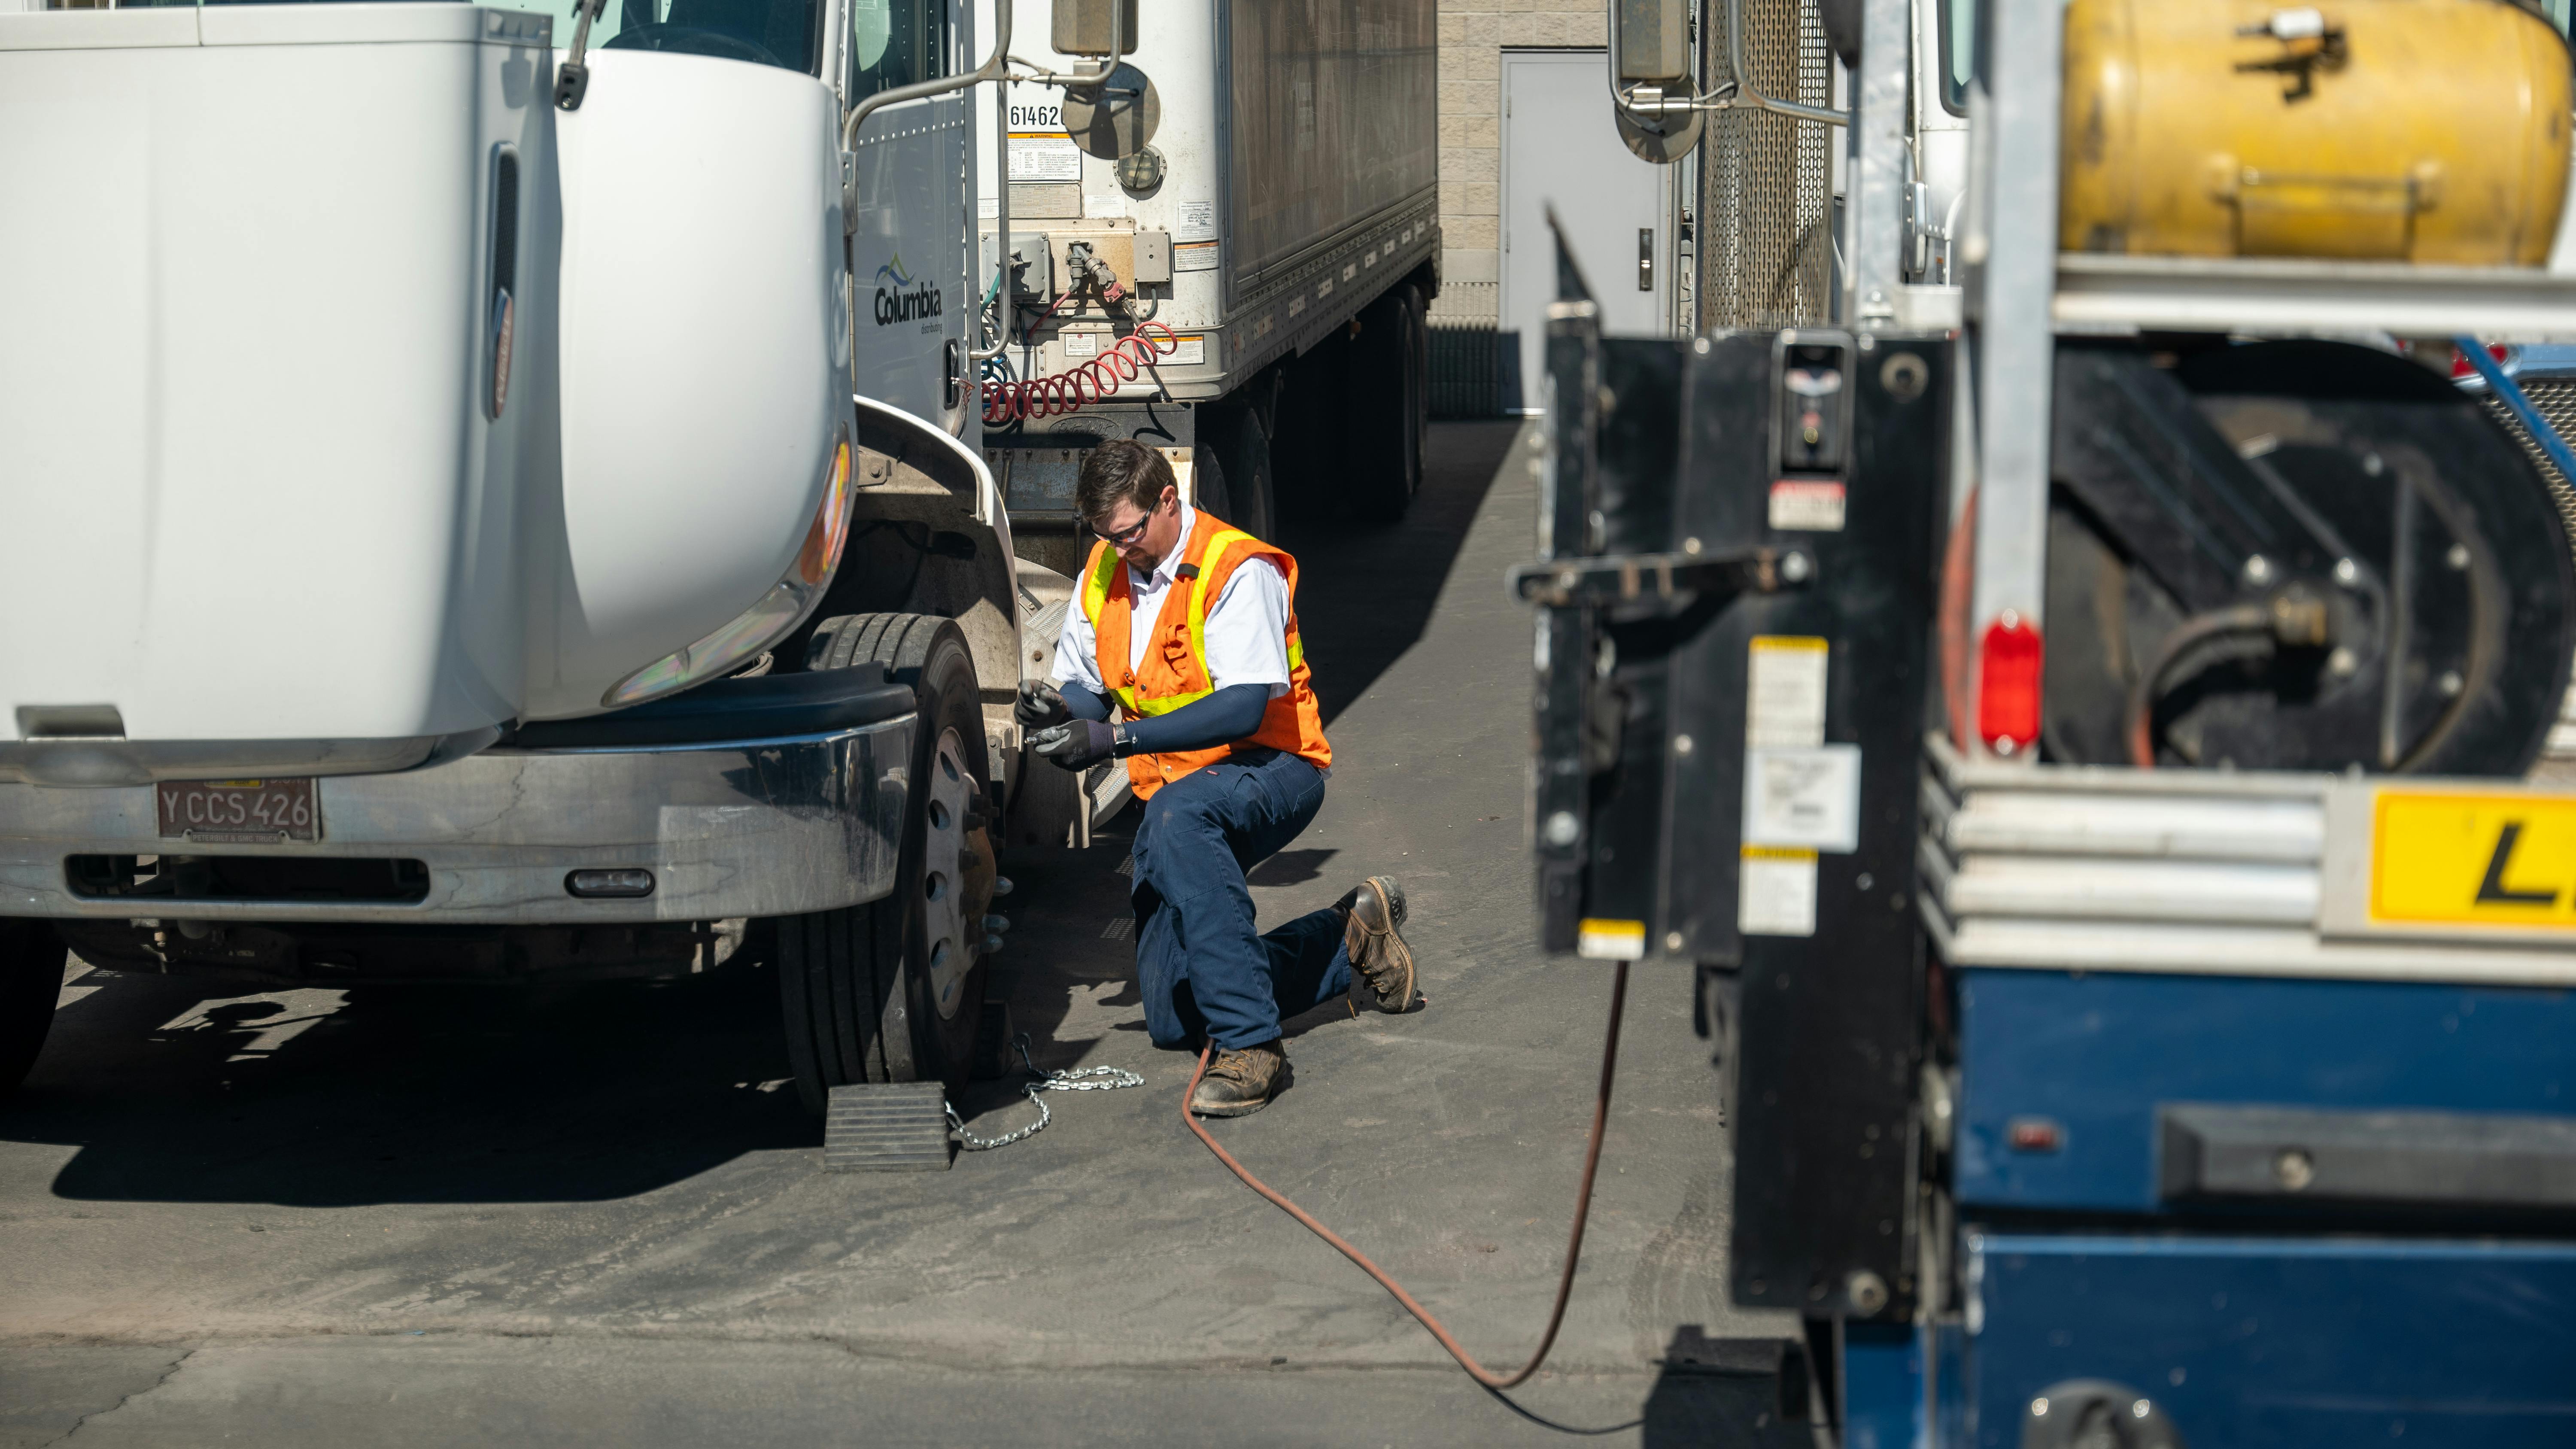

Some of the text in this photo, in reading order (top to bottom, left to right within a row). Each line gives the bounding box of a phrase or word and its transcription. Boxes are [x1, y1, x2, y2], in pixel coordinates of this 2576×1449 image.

[875, 280, 942, 326] Columbia
[921, 322, 942, 334] distributing
[252, 793, 309, 826] 426
[2475, 823, 2576, 906] L
